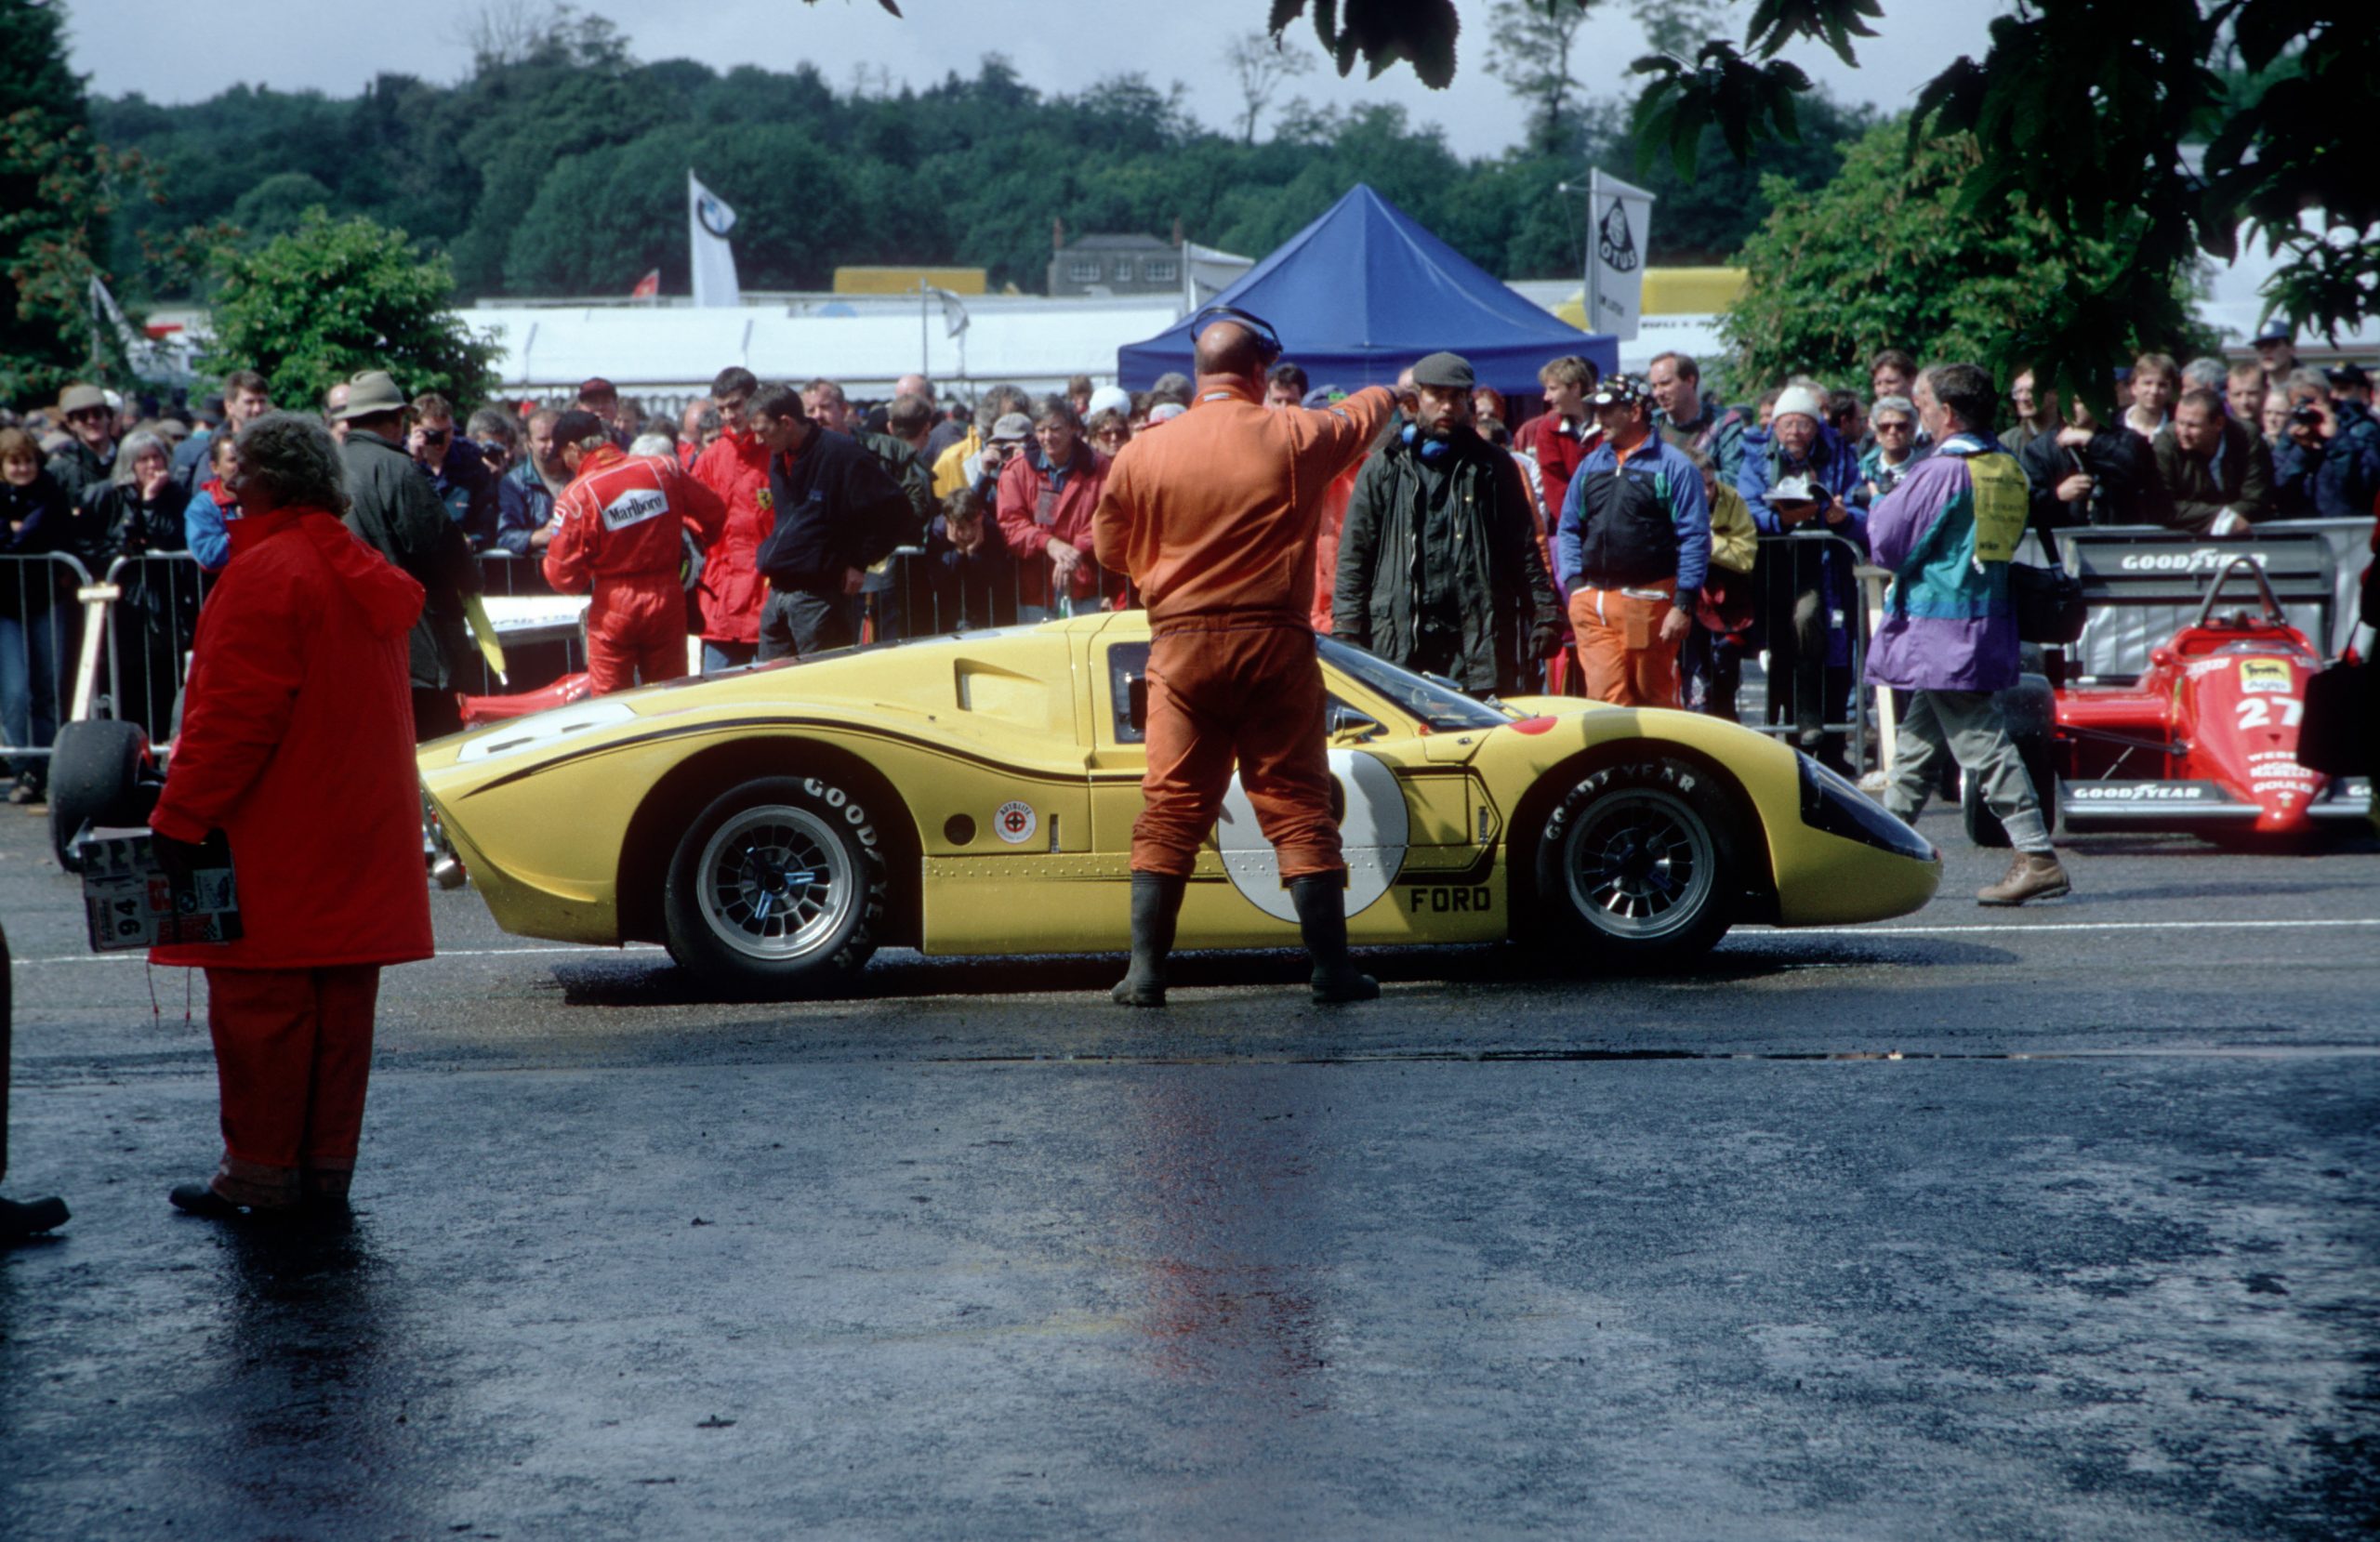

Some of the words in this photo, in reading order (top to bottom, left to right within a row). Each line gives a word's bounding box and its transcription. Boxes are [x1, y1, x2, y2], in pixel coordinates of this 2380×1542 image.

[1600, 241, 1637, 270] OTUS
[609, 495, 663, 524] Marlboro
[2236, 697, 2305, 731] 27
[2073, 784, 2202, 800] GOODYEAR
[1410, 887, 1491, 913] FORD
[114, 898, 141, 936] 94
